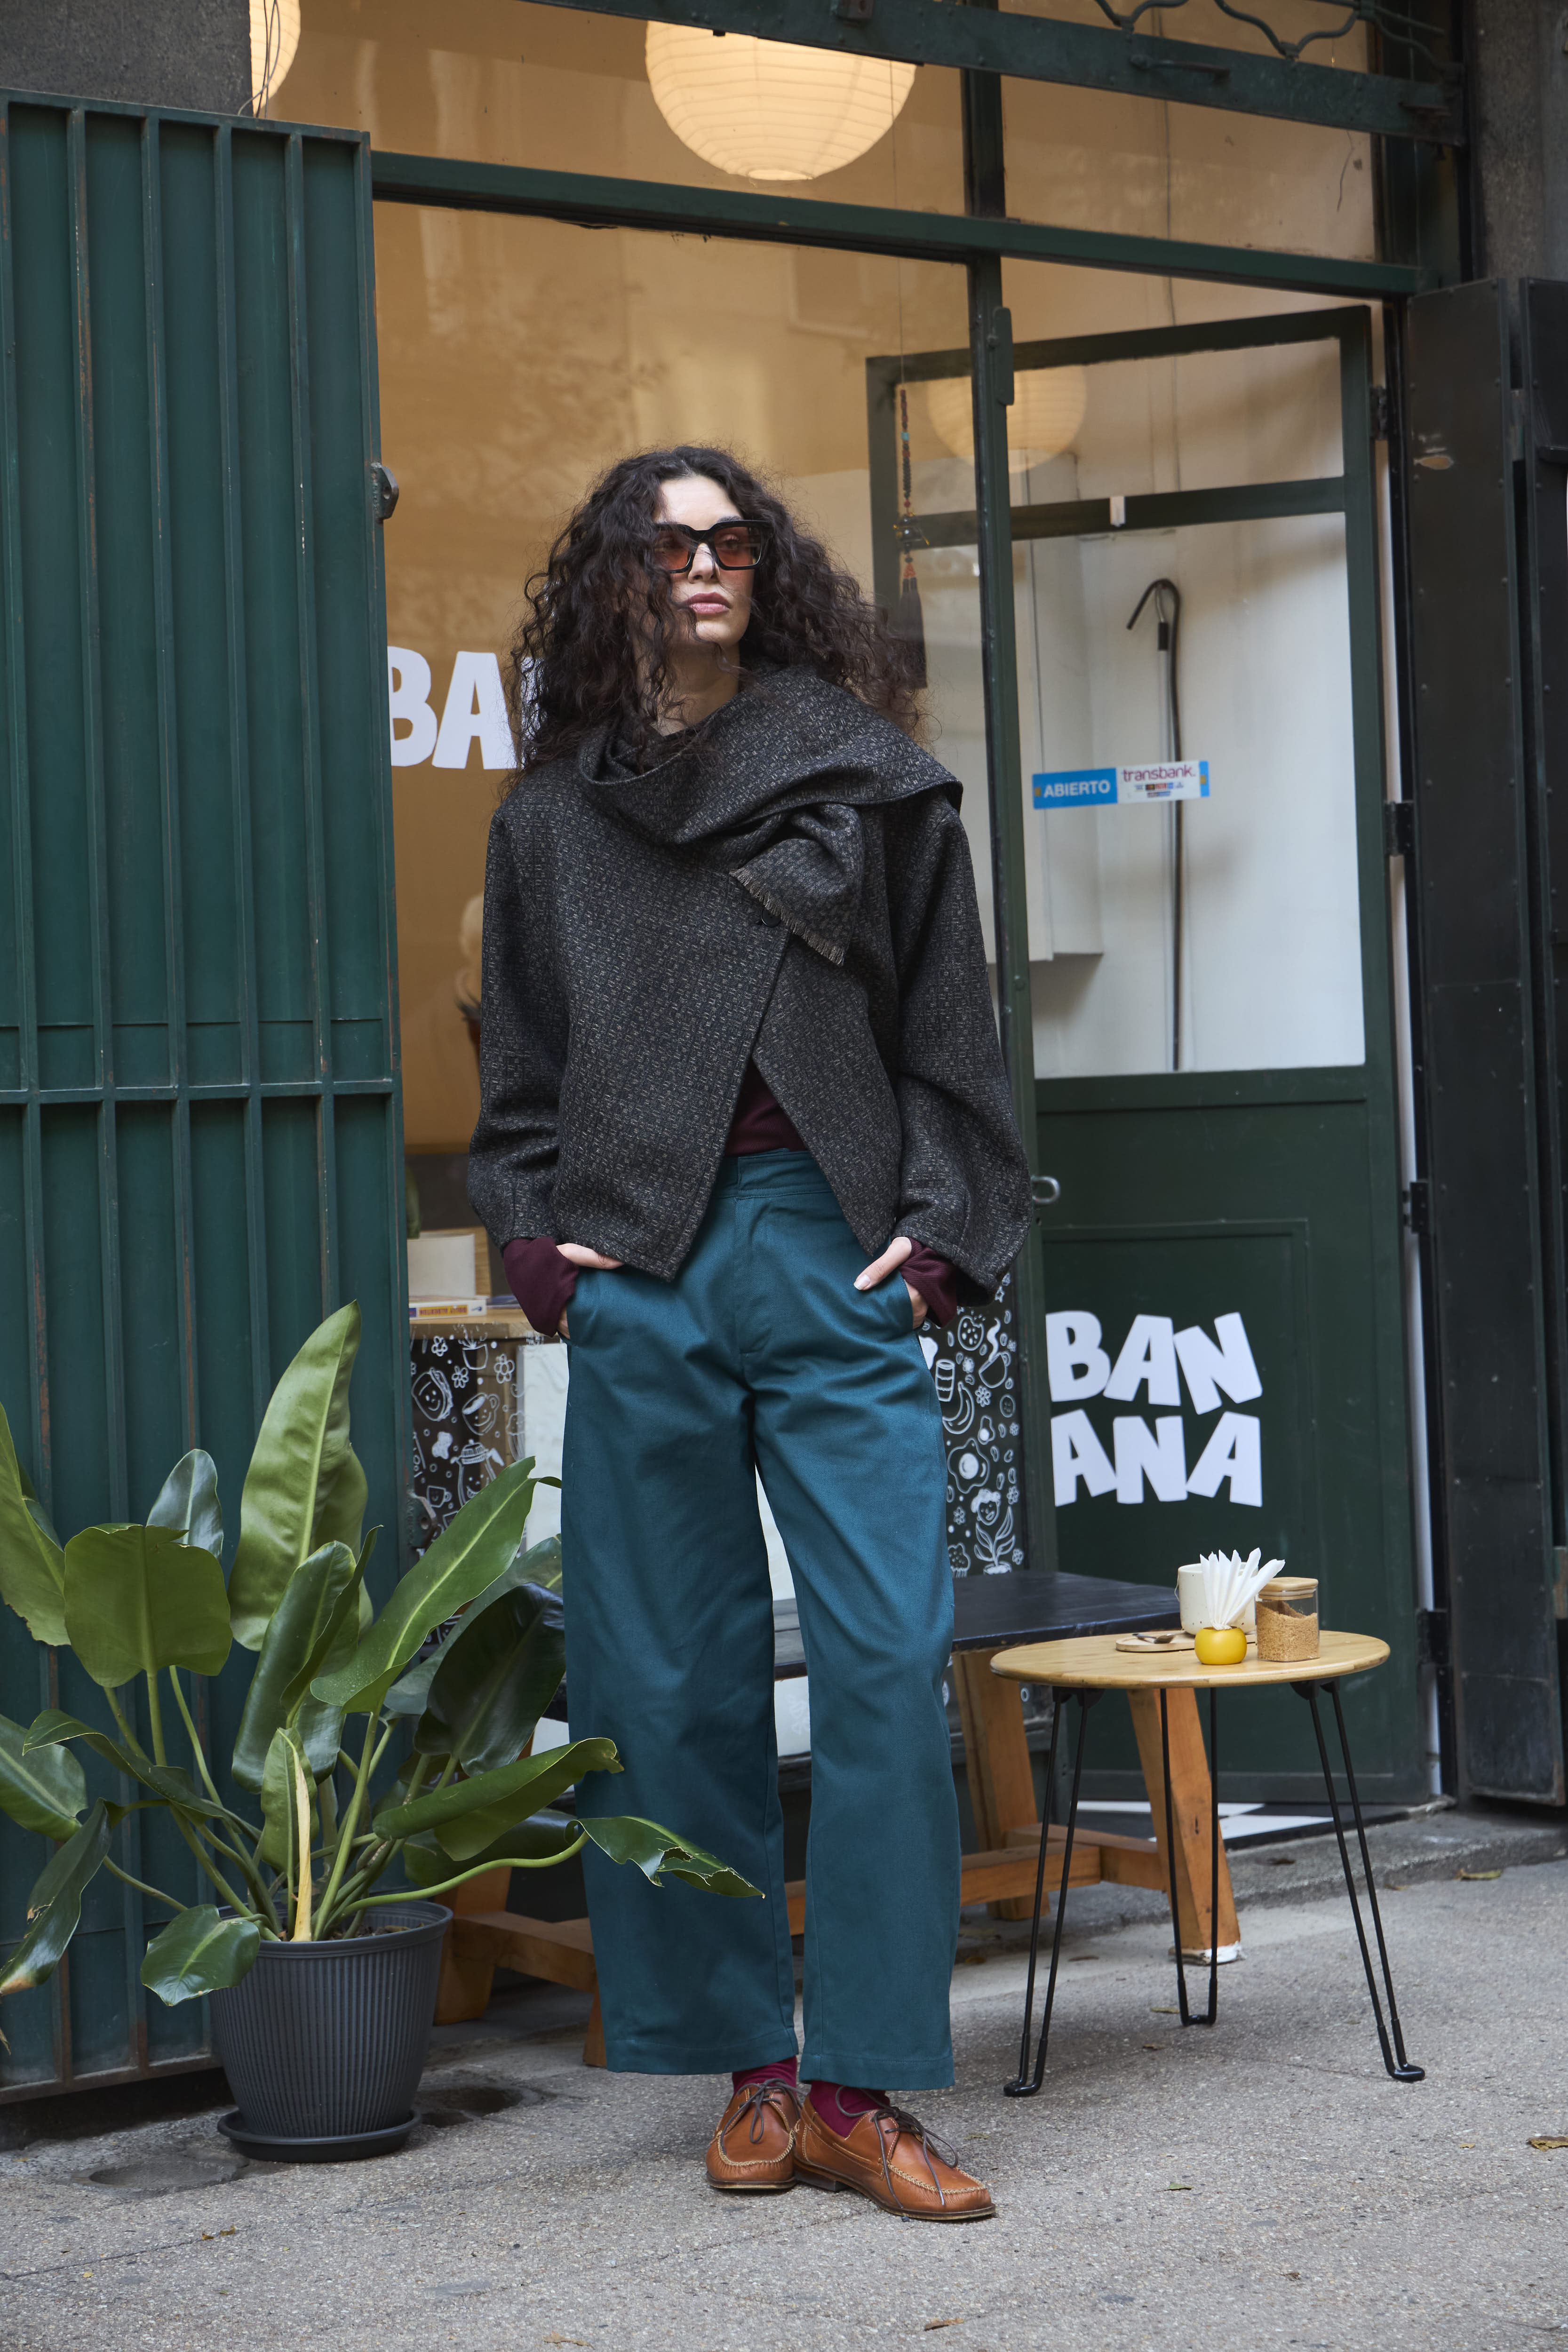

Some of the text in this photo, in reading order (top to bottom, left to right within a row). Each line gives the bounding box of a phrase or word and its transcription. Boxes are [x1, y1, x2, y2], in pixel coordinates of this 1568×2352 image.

[1043, 779, 1111, 798] ABIERTO
[1045, 1310, 1263, 1415] BAN
[1051, 1408, 1262, 1507] ANA
